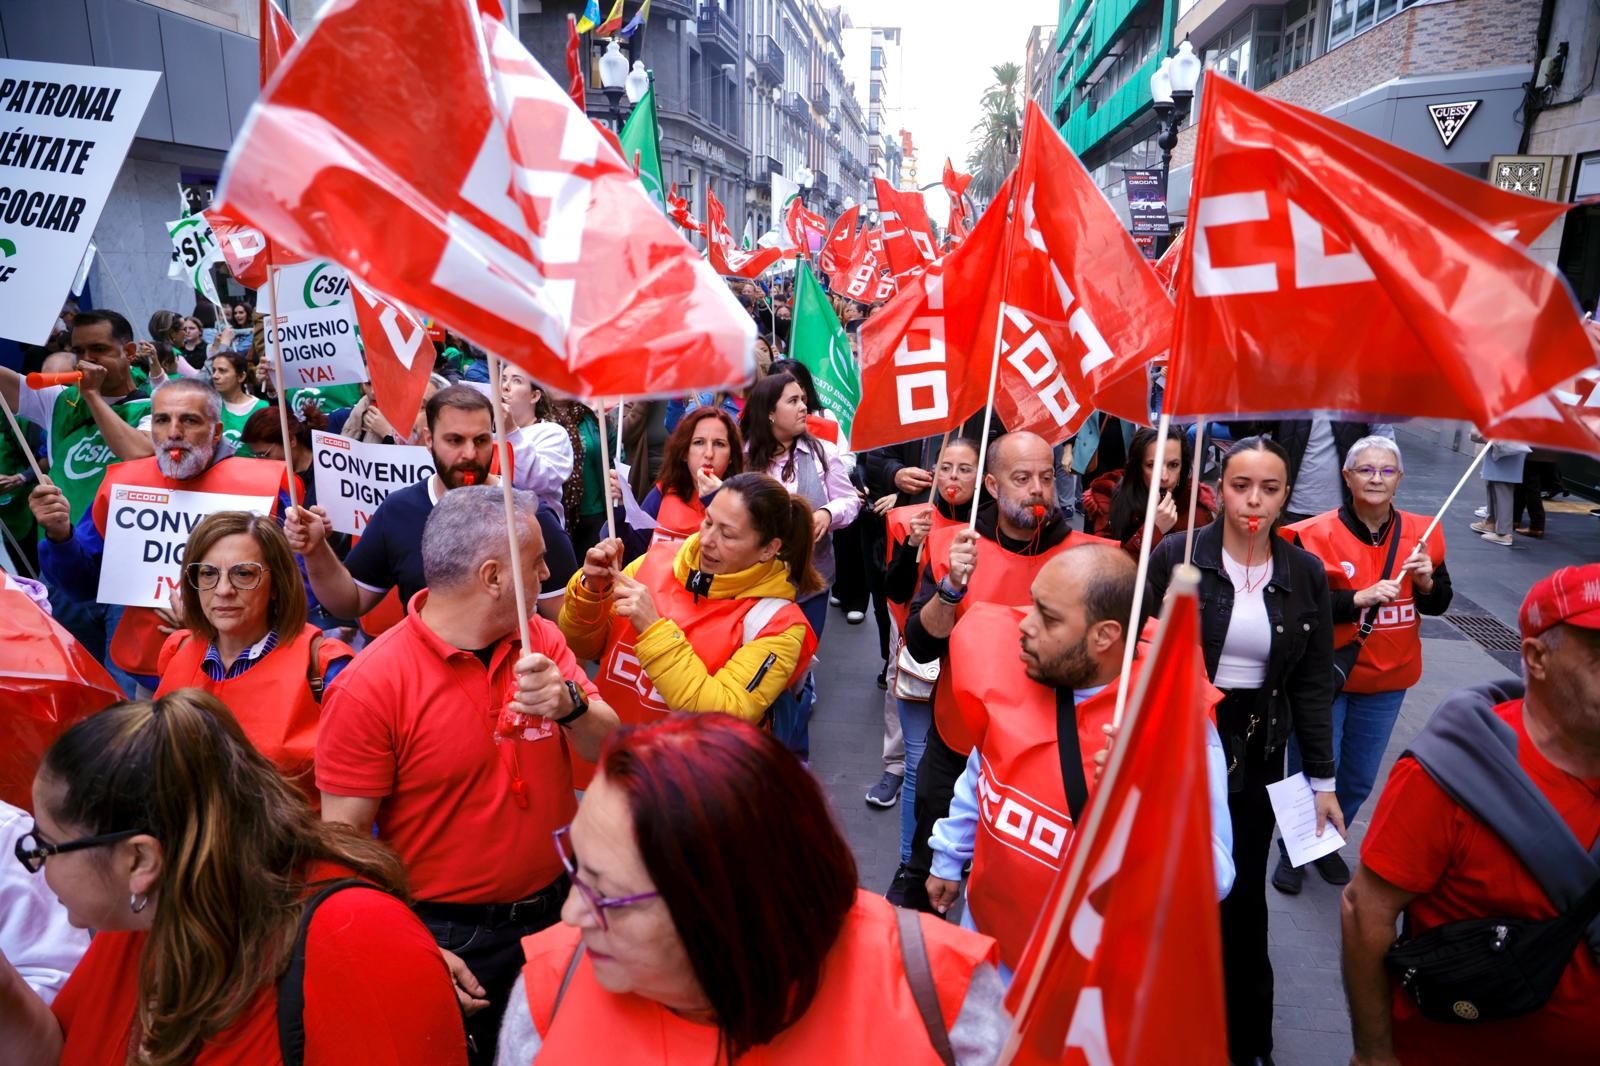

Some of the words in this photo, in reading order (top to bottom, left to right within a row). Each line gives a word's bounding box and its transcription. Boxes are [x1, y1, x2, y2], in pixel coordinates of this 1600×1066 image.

[0, 78, 121, 122] PATRONAL
[1435, 106, 1467, 118] GUESS
[267, 318, 349, 344] CONVENIO
[282, 342, 337, 362] DIGNO
[298, 364, 336, 384] ¡YA!
[340, 479, 389, 506] DIGN
[115, 506, 208, 535] CONV
